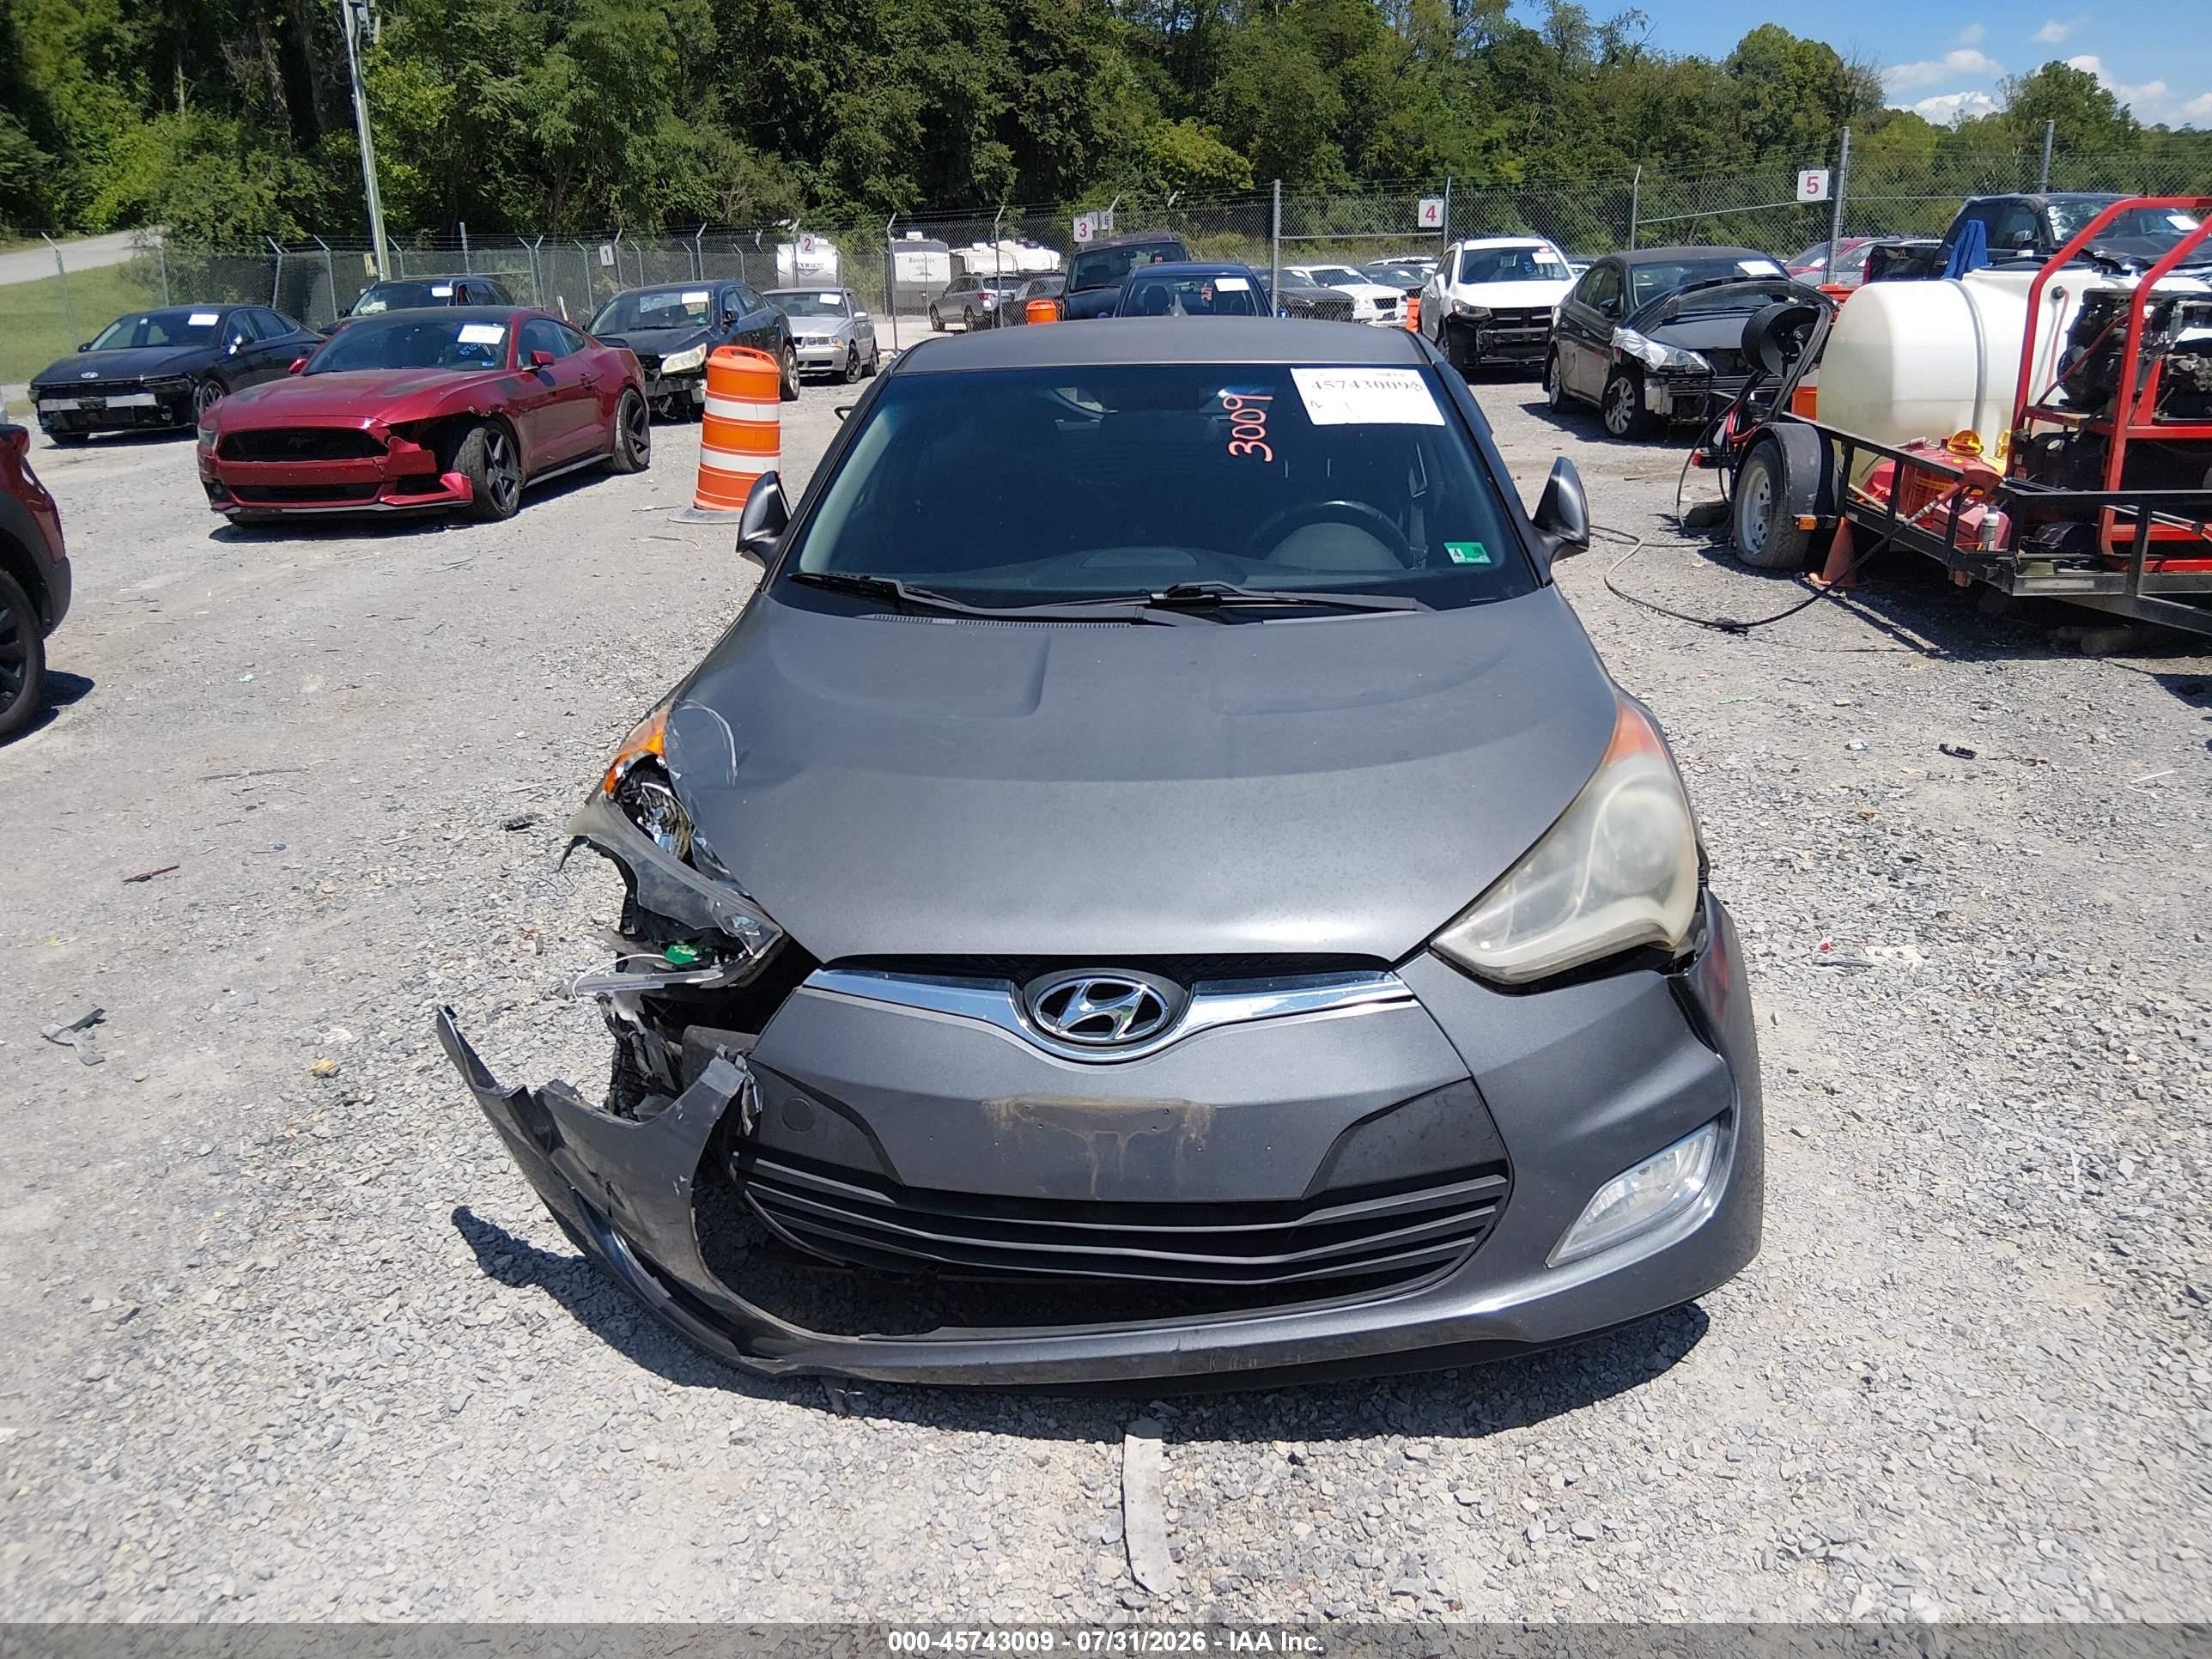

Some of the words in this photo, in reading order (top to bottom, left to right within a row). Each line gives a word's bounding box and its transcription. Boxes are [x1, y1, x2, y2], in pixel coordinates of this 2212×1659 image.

[1806, 176, 1820, 195] 5
[1425, 204, 1437, 222] 4
[1079, 222, 1087, 238] 3
[804, 237, 811, 252] 2
[604, 248, 610, 262] 1
[1223, 395, 1273, 462] 3009
